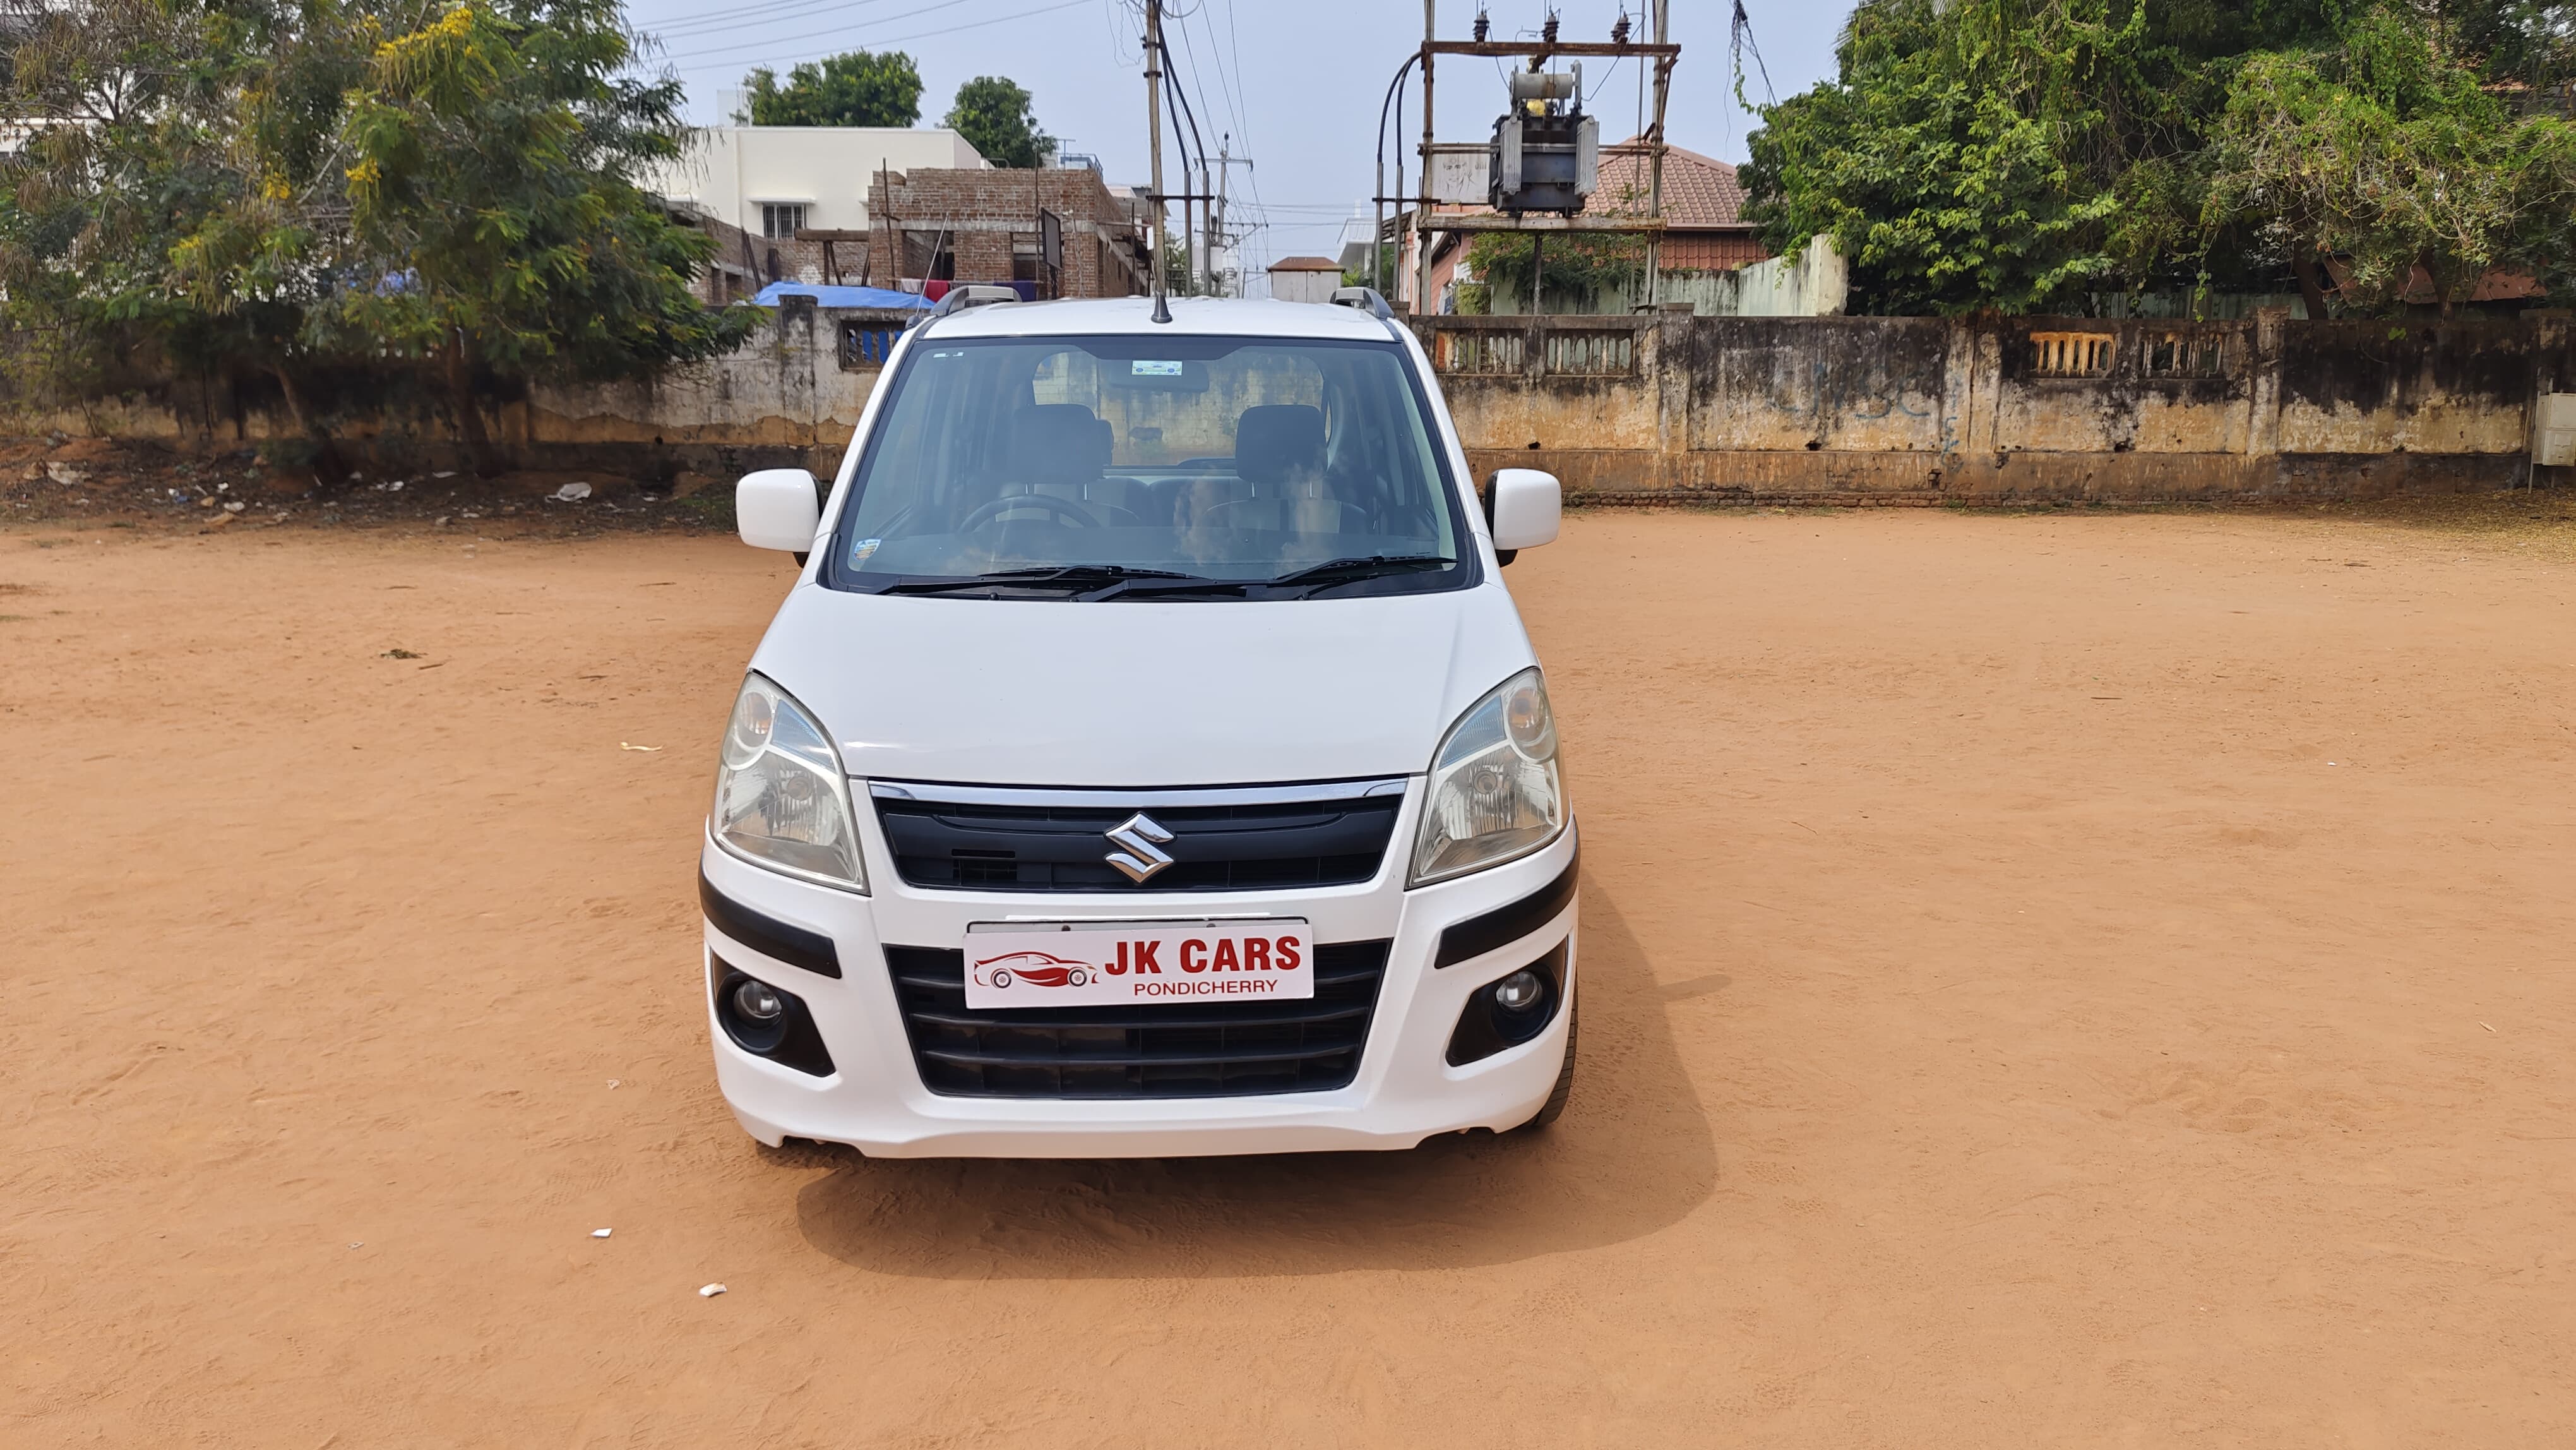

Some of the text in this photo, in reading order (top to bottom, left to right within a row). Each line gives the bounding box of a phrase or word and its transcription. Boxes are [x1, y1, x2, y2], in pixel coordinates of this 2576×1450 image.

[1104, 935, 1301, 976] JK CARS
[1134, 979, 1279, 997] PONDICHERRY
